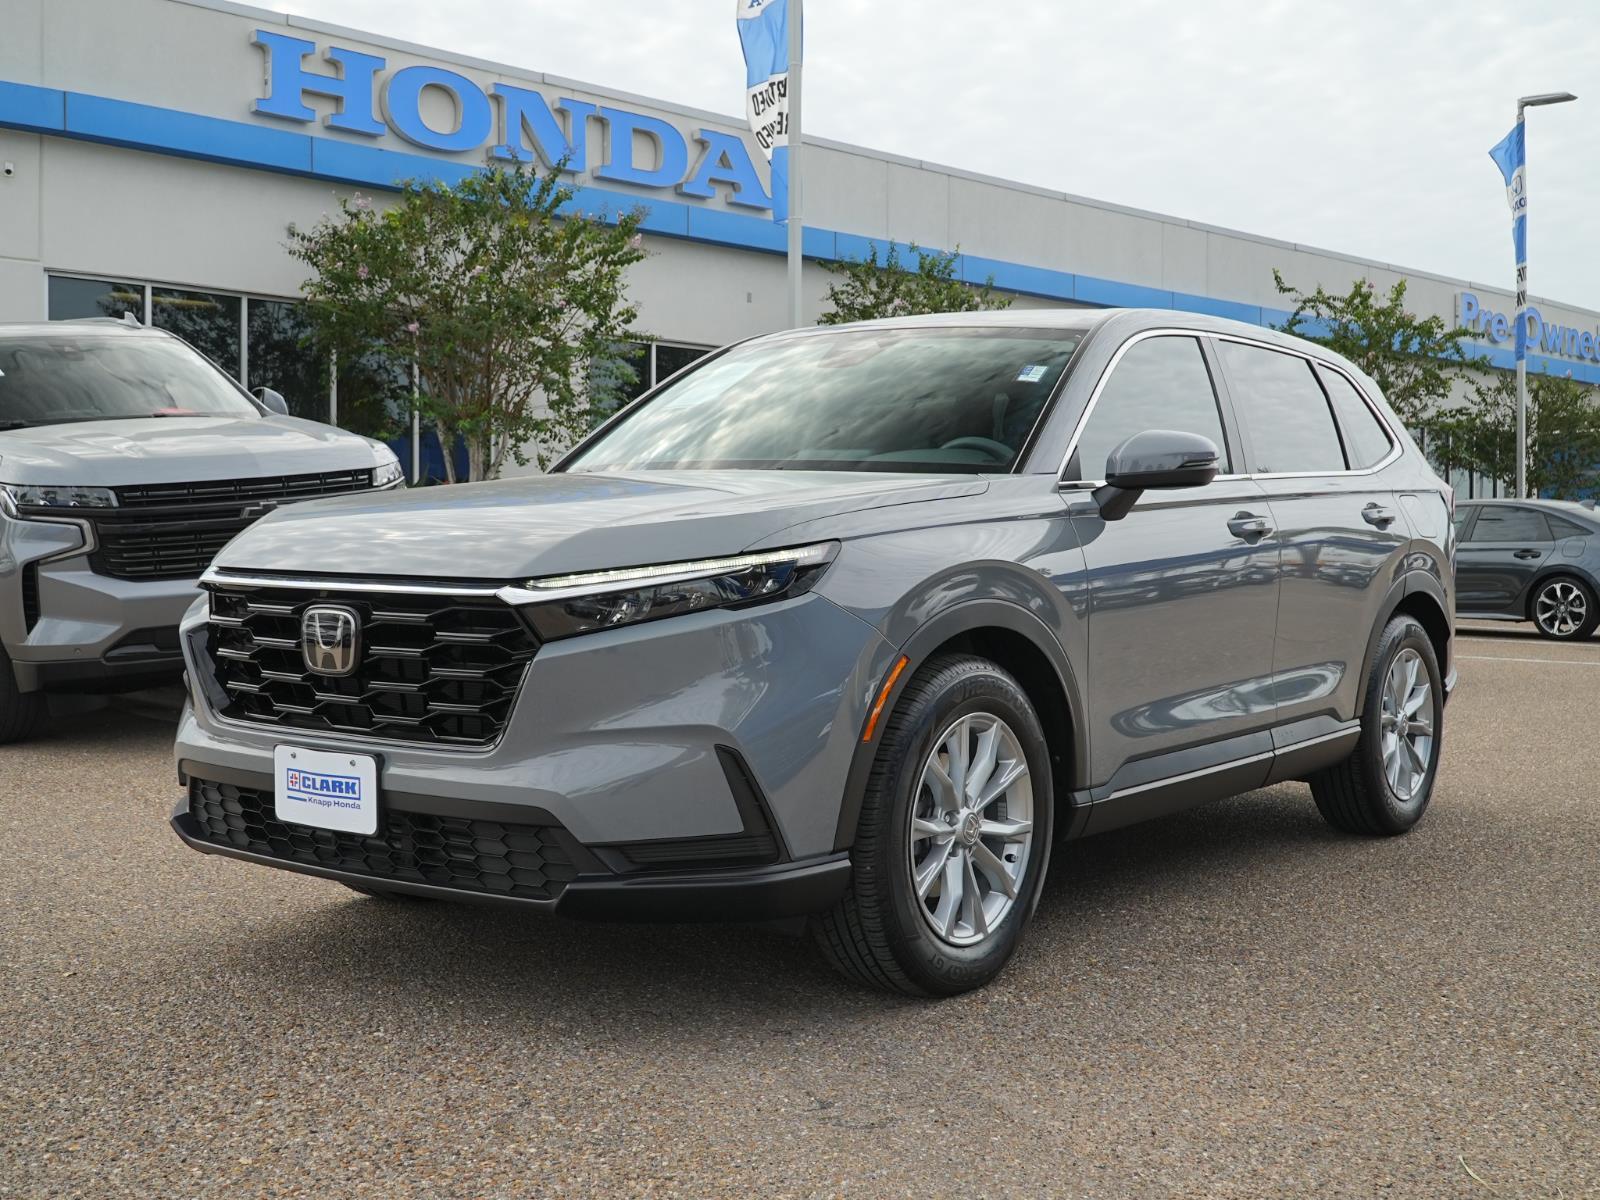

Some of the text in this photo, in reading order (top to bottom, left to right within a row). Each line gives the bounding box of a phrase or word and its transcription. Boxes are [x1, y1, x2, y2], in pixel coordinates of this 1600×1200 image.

[250, 29, 773, 210] HONDA
[1459, 292, 1600, 362] Pre-Owne
[301, 775, 357, 795] CLARK
[308, 797, 361, 810] Knapp Honda
